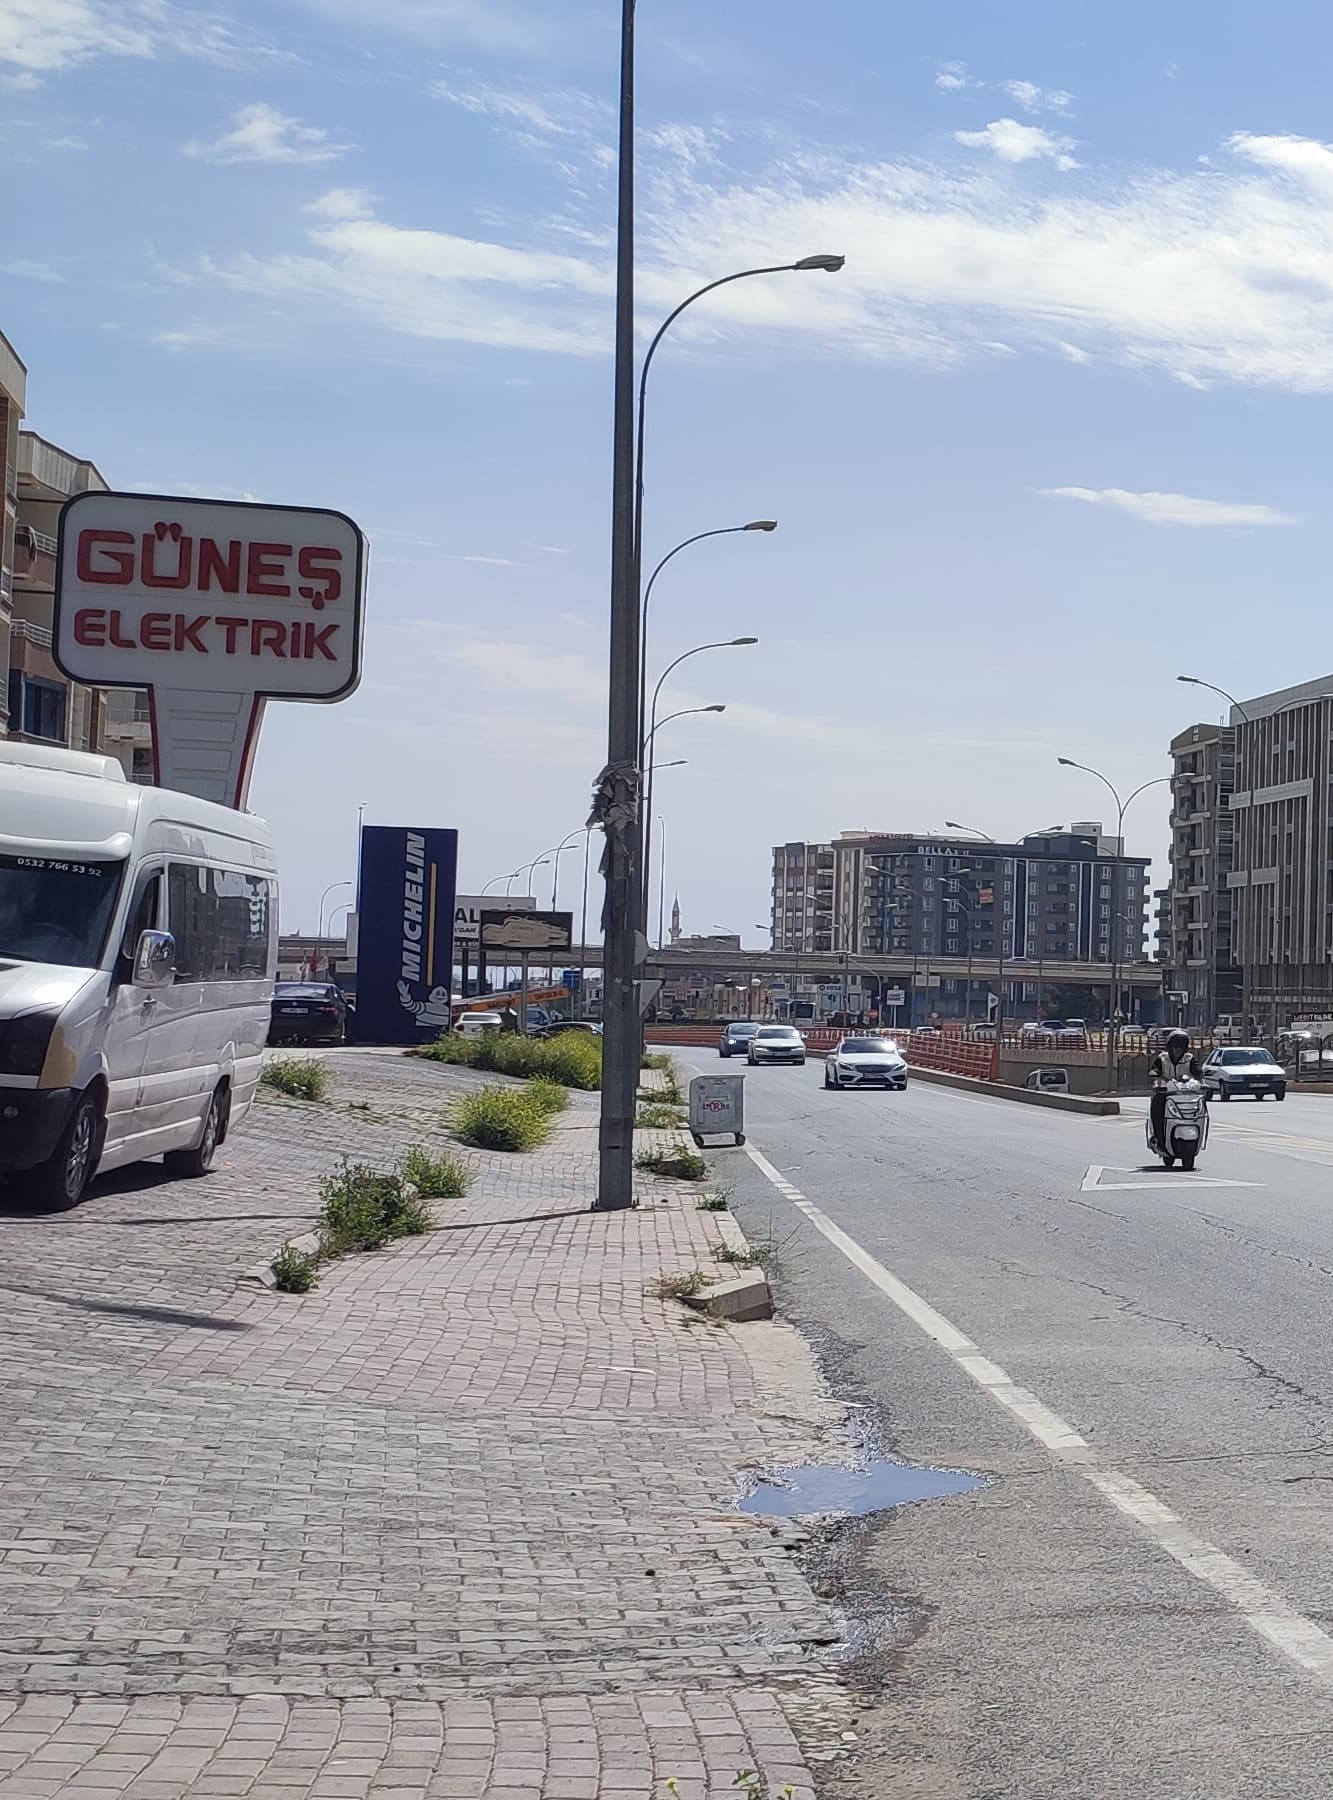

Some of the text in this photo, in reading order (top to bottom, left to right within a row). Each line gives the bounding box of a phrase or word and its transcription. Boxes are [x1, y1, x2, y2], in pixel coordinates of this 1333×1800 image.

[77, 521, 343, 610] GÜNEŞ
[17, 858, 102, 877] 0532 766 53 92
[402, 832, 425, 982] MICHELIN
